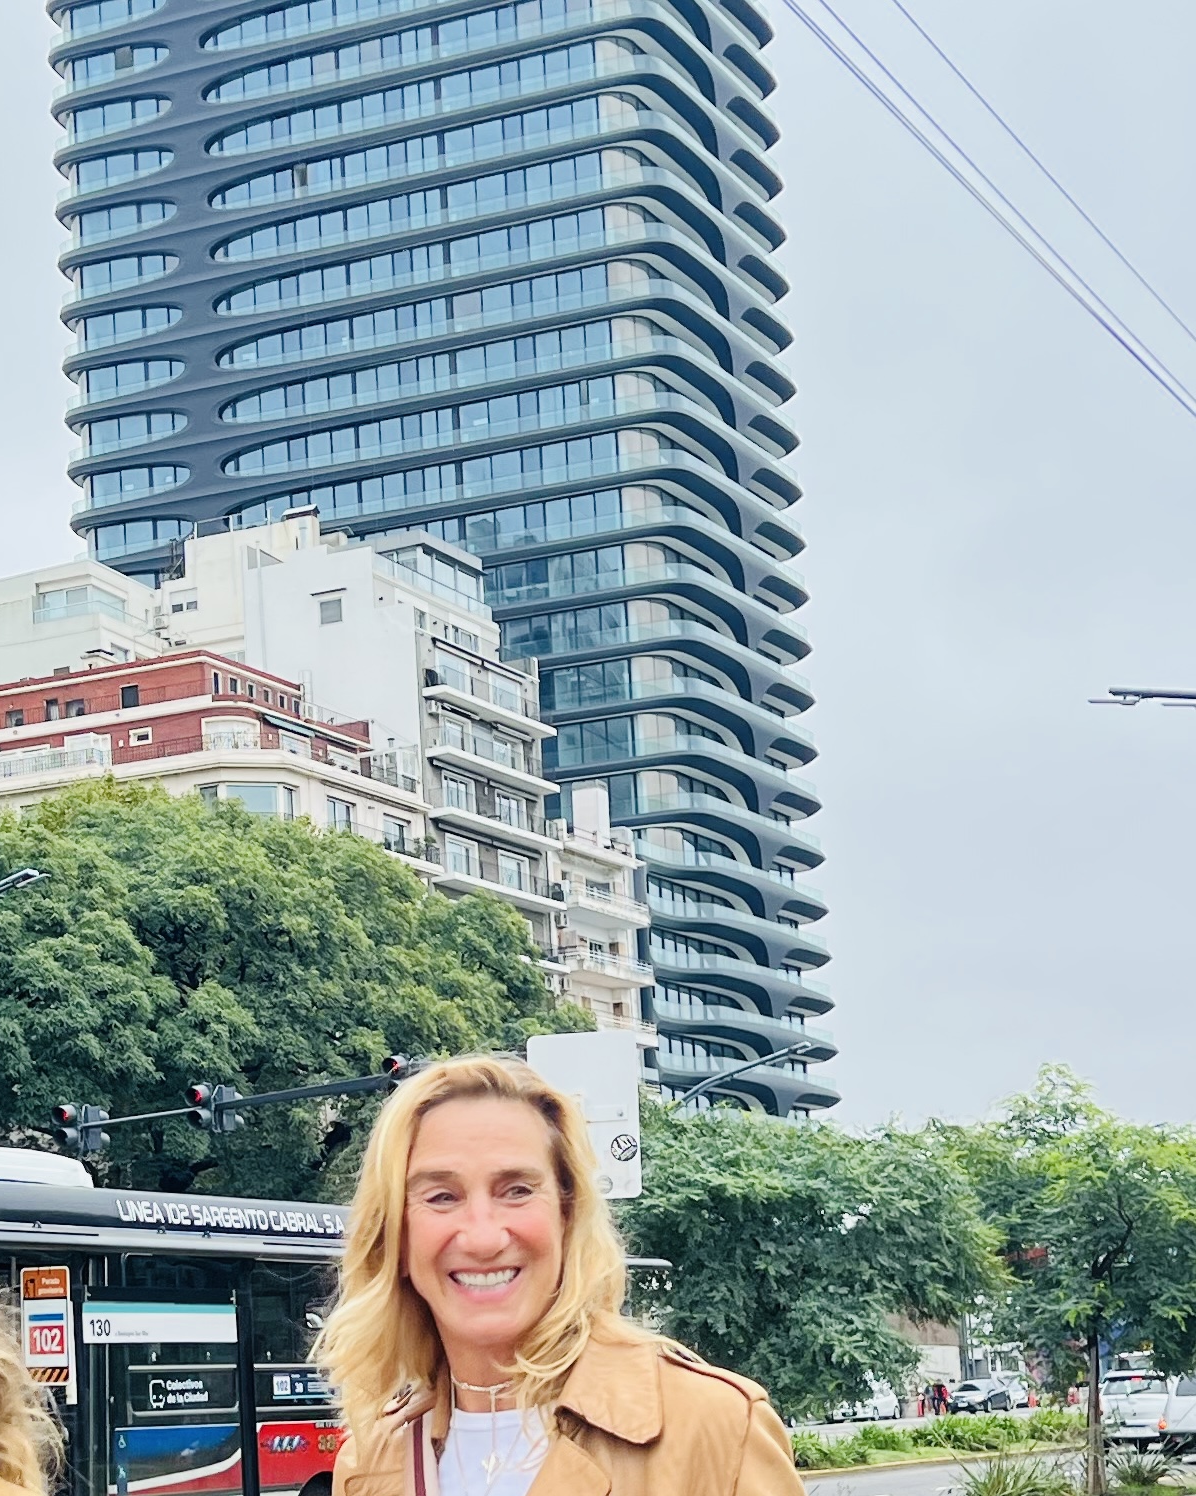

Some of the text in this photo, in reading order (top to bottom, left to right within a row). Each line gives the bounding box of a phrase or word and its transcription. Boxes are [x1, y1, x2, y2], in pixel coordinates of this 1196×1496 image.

[116, 1199, 166, 1224] LINEA
[163, 1202, 192, 1226] 102
[191, 1205, 269, 1231] SARGENTO
[268, 1210, 325, 1233] CABRAL
[32, 1327, 63, 1353] 102
[89, 1319, 111, 1336] 130
